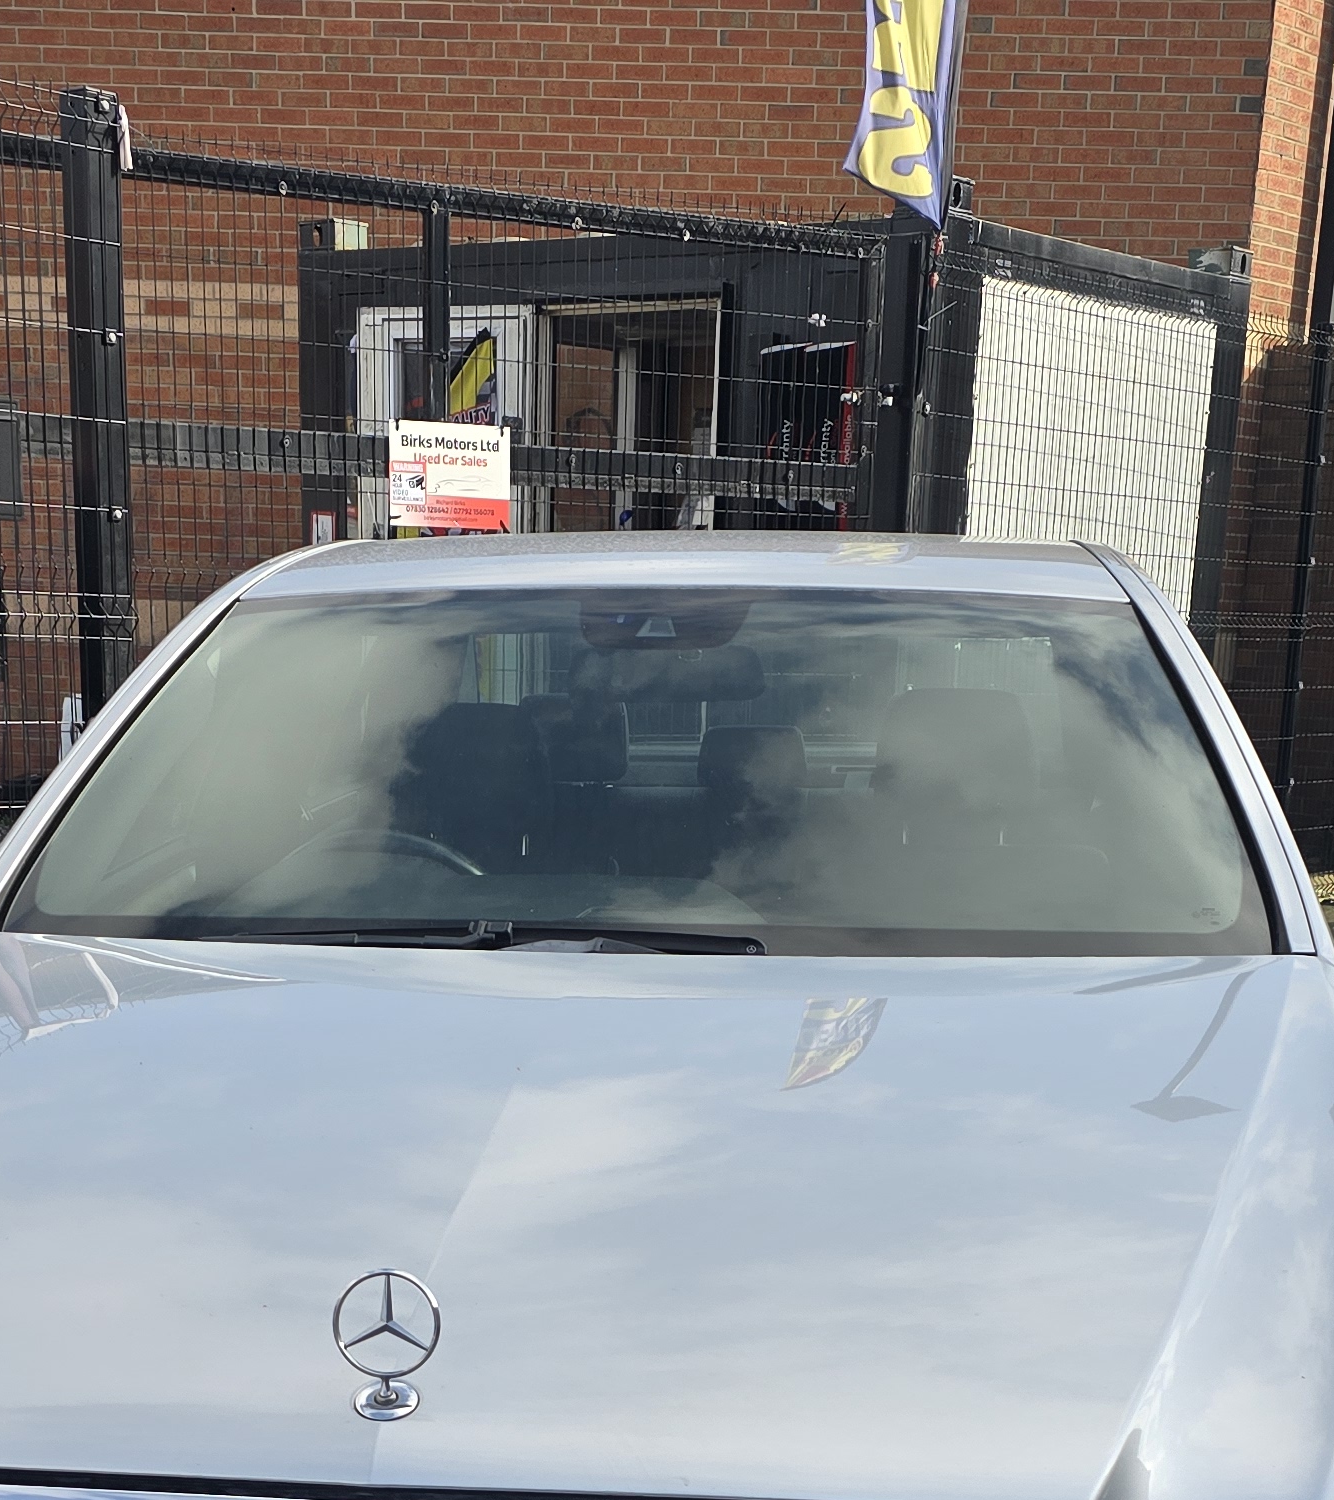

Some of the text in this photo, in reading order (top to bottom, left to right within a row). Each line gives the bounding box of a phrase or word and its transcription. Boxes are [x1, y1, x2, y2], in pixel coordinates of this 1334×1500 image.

[401, 434, 499, 452] Birks Motors Ltd
[413, 452, 488, 467] Used Car Sales
[392, 473, 402, 482] 24
